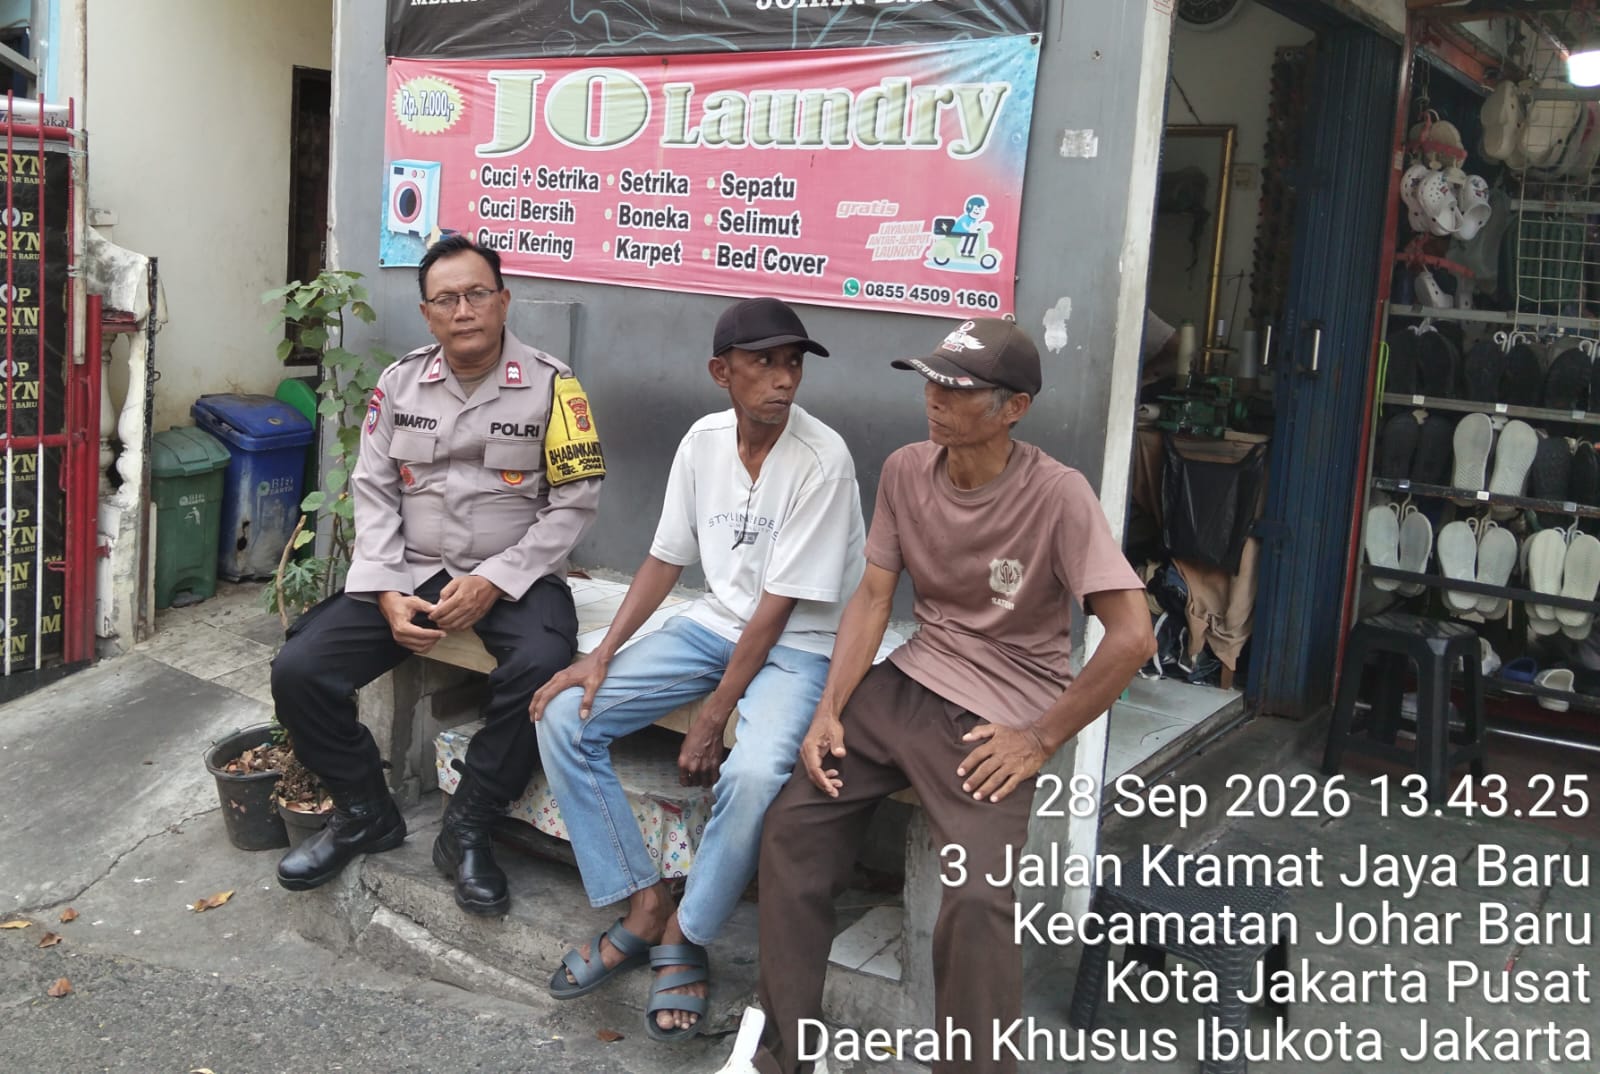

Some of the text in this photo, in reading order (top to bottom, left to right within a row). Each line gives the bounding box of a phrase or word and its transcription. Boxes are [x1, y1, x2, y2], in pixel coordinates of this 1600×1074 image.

[401, 90, 418, 121] Rp.
[475, 67, 1011, 159] JO Laundry
[481, 165, 517, 187] Cuci
[536, 167, 599, 191] Setrika
[620, 171, 689, 195] Setrika
[721, 172, 796, 204] Sepatu
[479, 197, 575, 223] Cuci Bersih
[618, 205, 689, 230] Boneka
[837, 200, 898, 217] gratis
[718, 209, 800, 237] Selimut
[477, 229, 574, 260] Cuci Kering
[615, 237, 682, 266] Karpet
[716, 245, 827, 275] Bed Cover
[864, 282, 999, 308] 0855 4509 1660
[490, 422, 540, 437] POLRI
